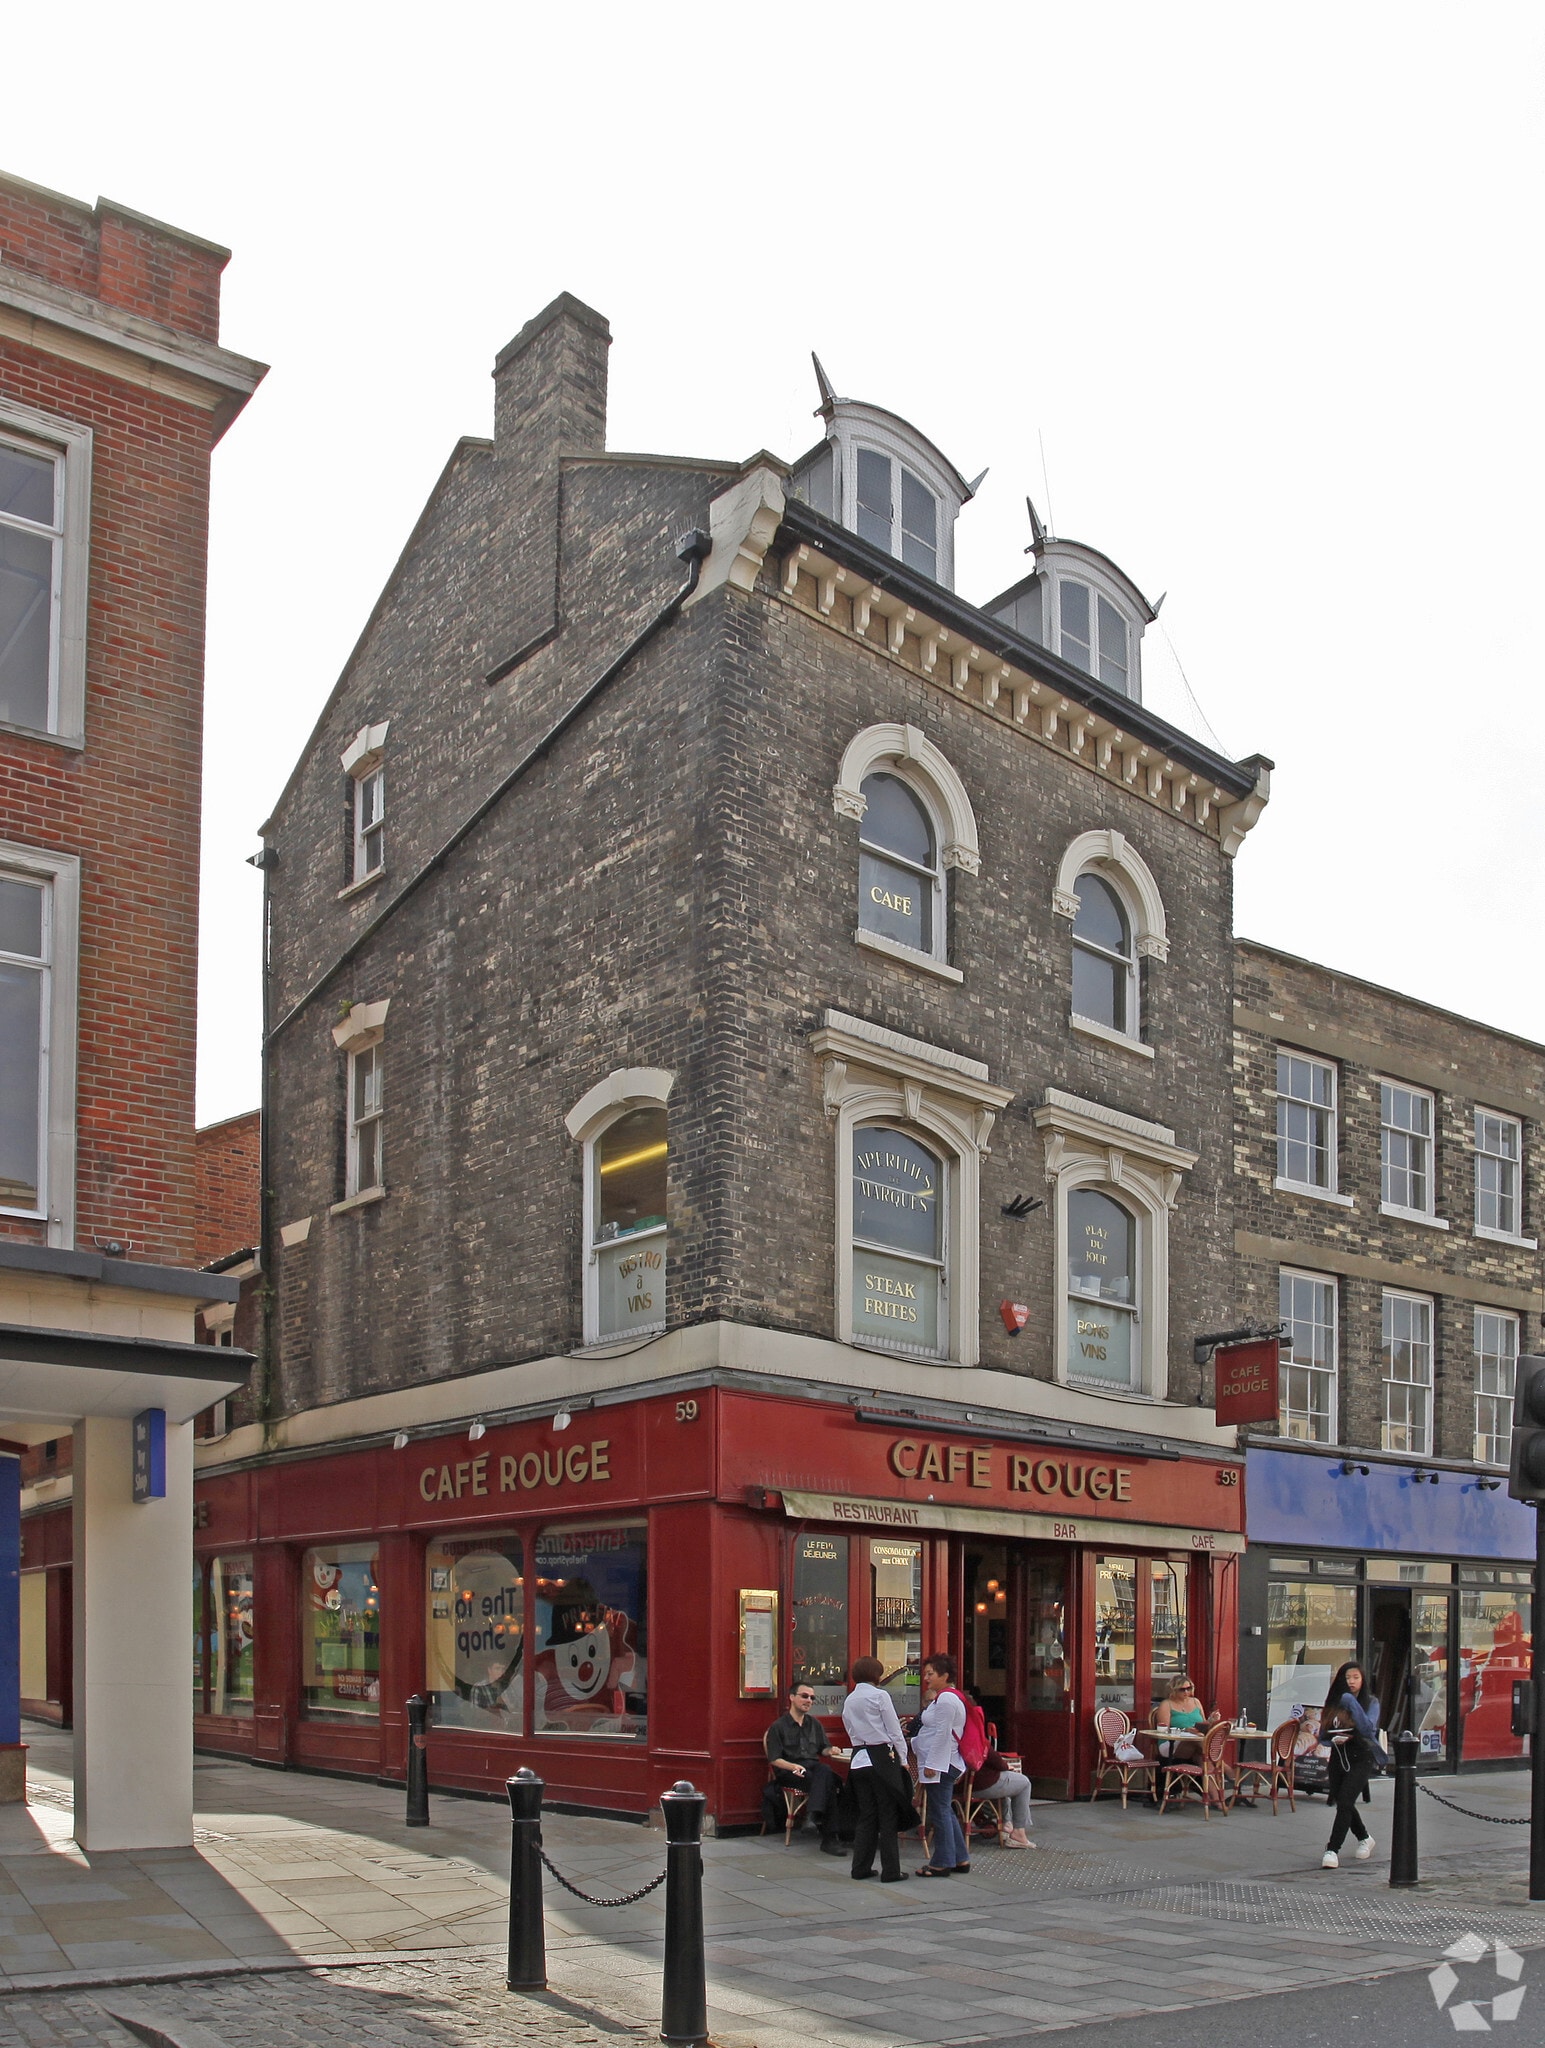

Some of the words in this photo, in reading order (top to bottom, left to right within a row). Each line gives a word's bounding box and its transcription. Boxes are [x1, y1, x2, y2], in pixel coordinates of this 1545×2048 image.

[870, 886, 913, 916] CAFÉ
[860, 1180, 928, 1213] MARQUES
[618, 1251, 662, 1280] BISTRO
[865, 1274, 917, 1300] STEAK
[627, 1292, 653, 1314] VINS
[864, 1297, 918, 1323] FRITES
[1077, 1319, 1110, 1340] BONS
[1080, 1342, 1107, 1360] VINS
[1222, 1378, 1270, 1397] ROUGE
[675, 1399, 698, 1421] 59
[419, 1451, 491, 1502] CAFÉ
[500, 1440, 610, 1492] ROUGE
[892, 1439, 994, 1488] CAFÉ
[1013, 1454, 1133, 1501] ROUGE
[1221, 1469, 1238, 1486] 59
[832, 1501, 919, 1525] RESTAURANT
[1054, 1522, 1077, 1539] BAR
[1191, 1534, 1216, 1550] CAFÉ
[892, 1557, 909, 1566] CHOIX
